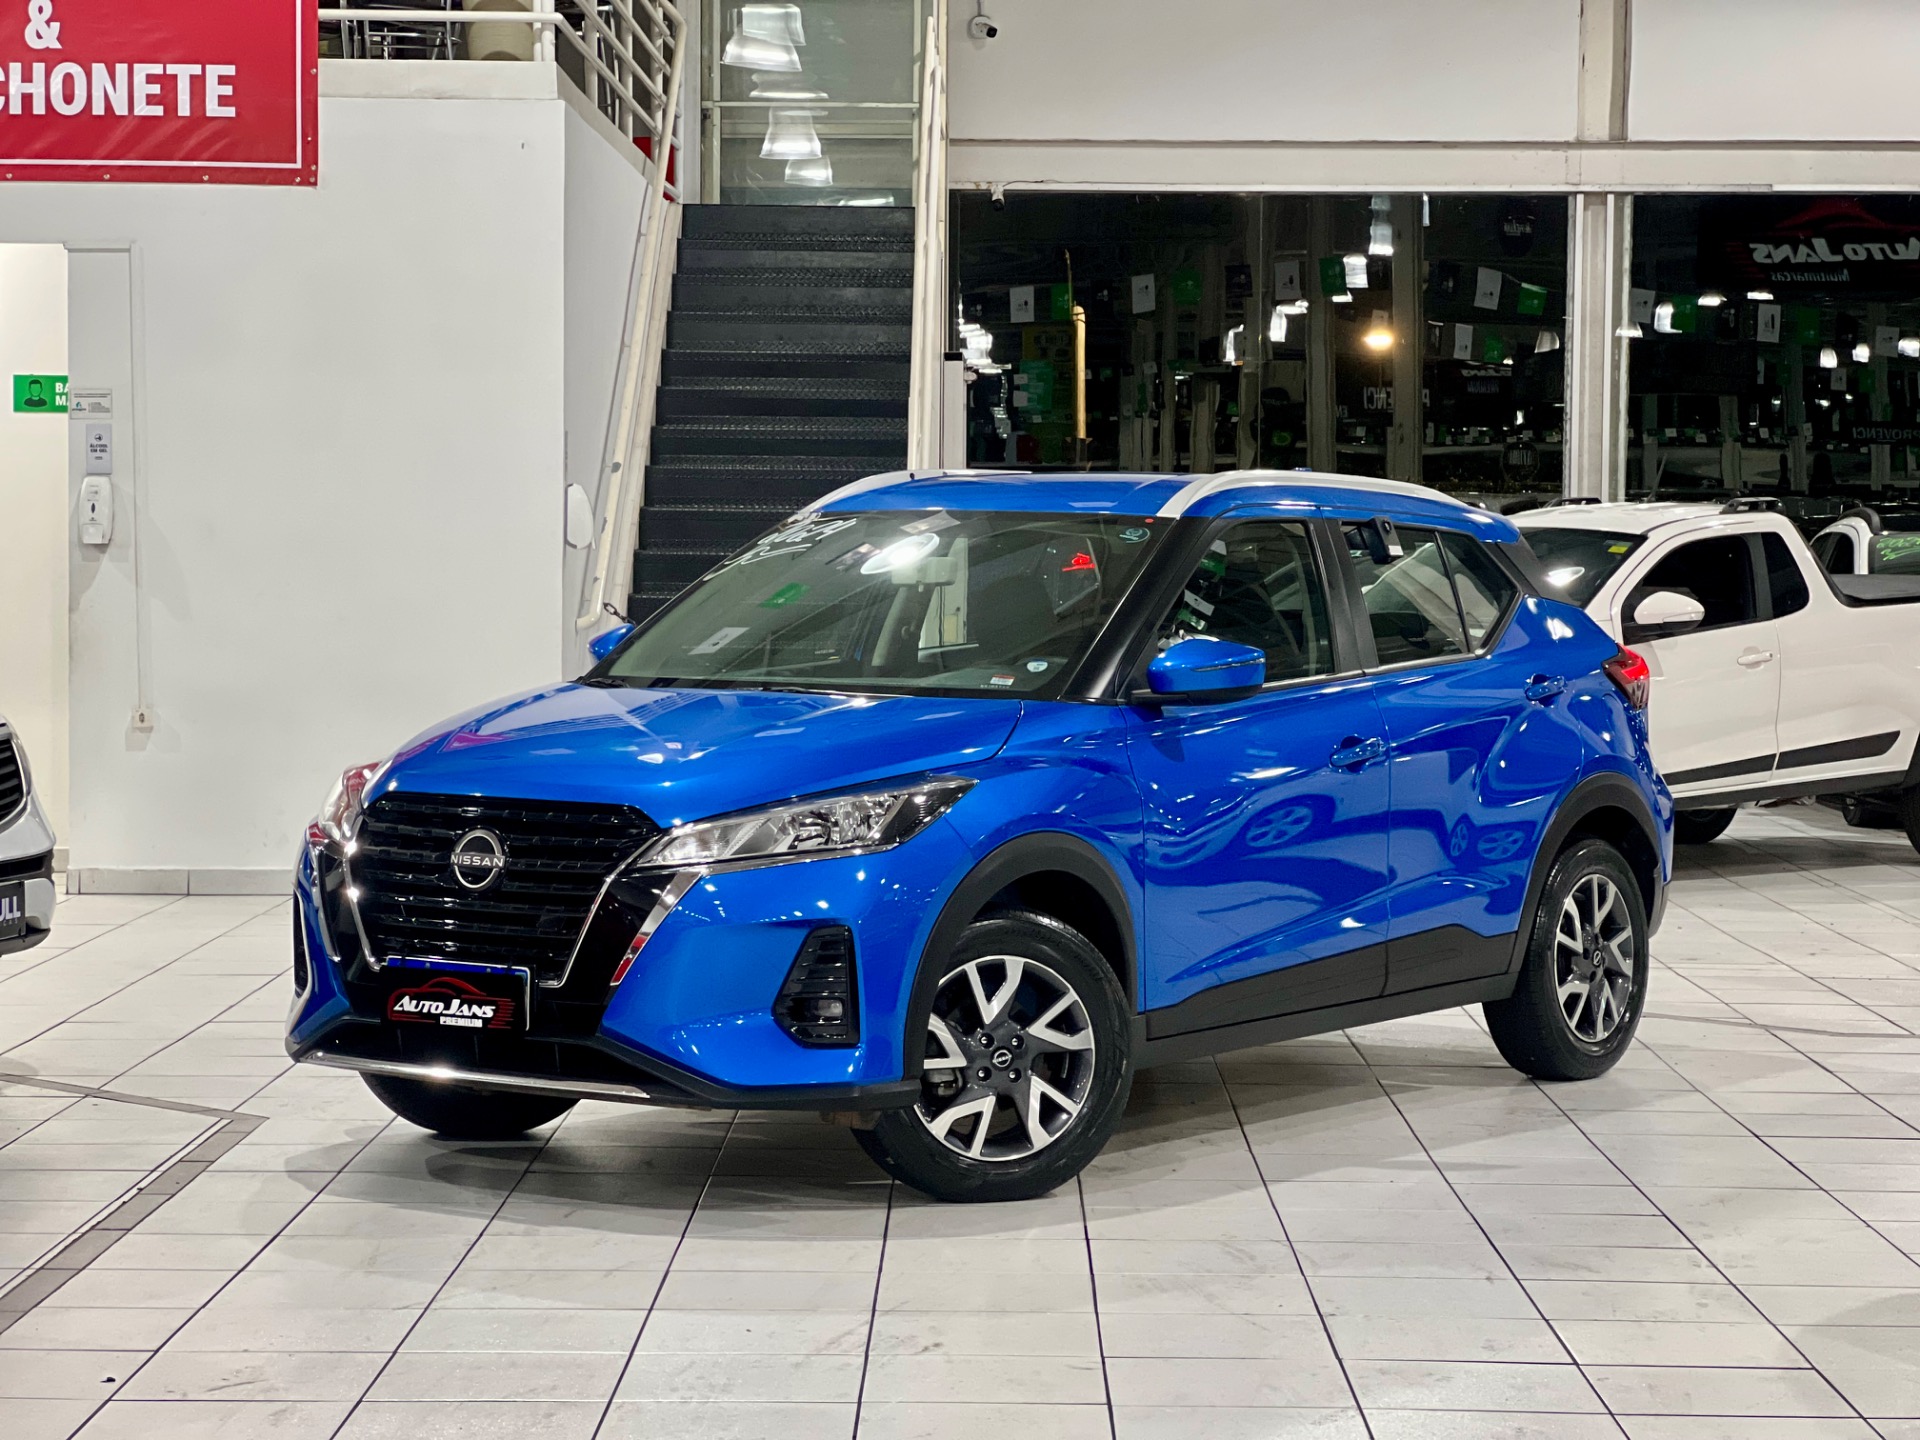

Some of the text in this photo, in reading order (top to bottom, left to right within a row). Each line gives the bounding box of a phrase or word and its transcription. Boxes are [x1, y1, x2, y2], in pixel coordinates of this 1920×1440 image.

[24, 0, 62, 49] &
[0, 62, 236, 117] HONETE
[451, 854, 504, 867] NISSAN
[440, 1016, 483, 1027] PREMIUM
